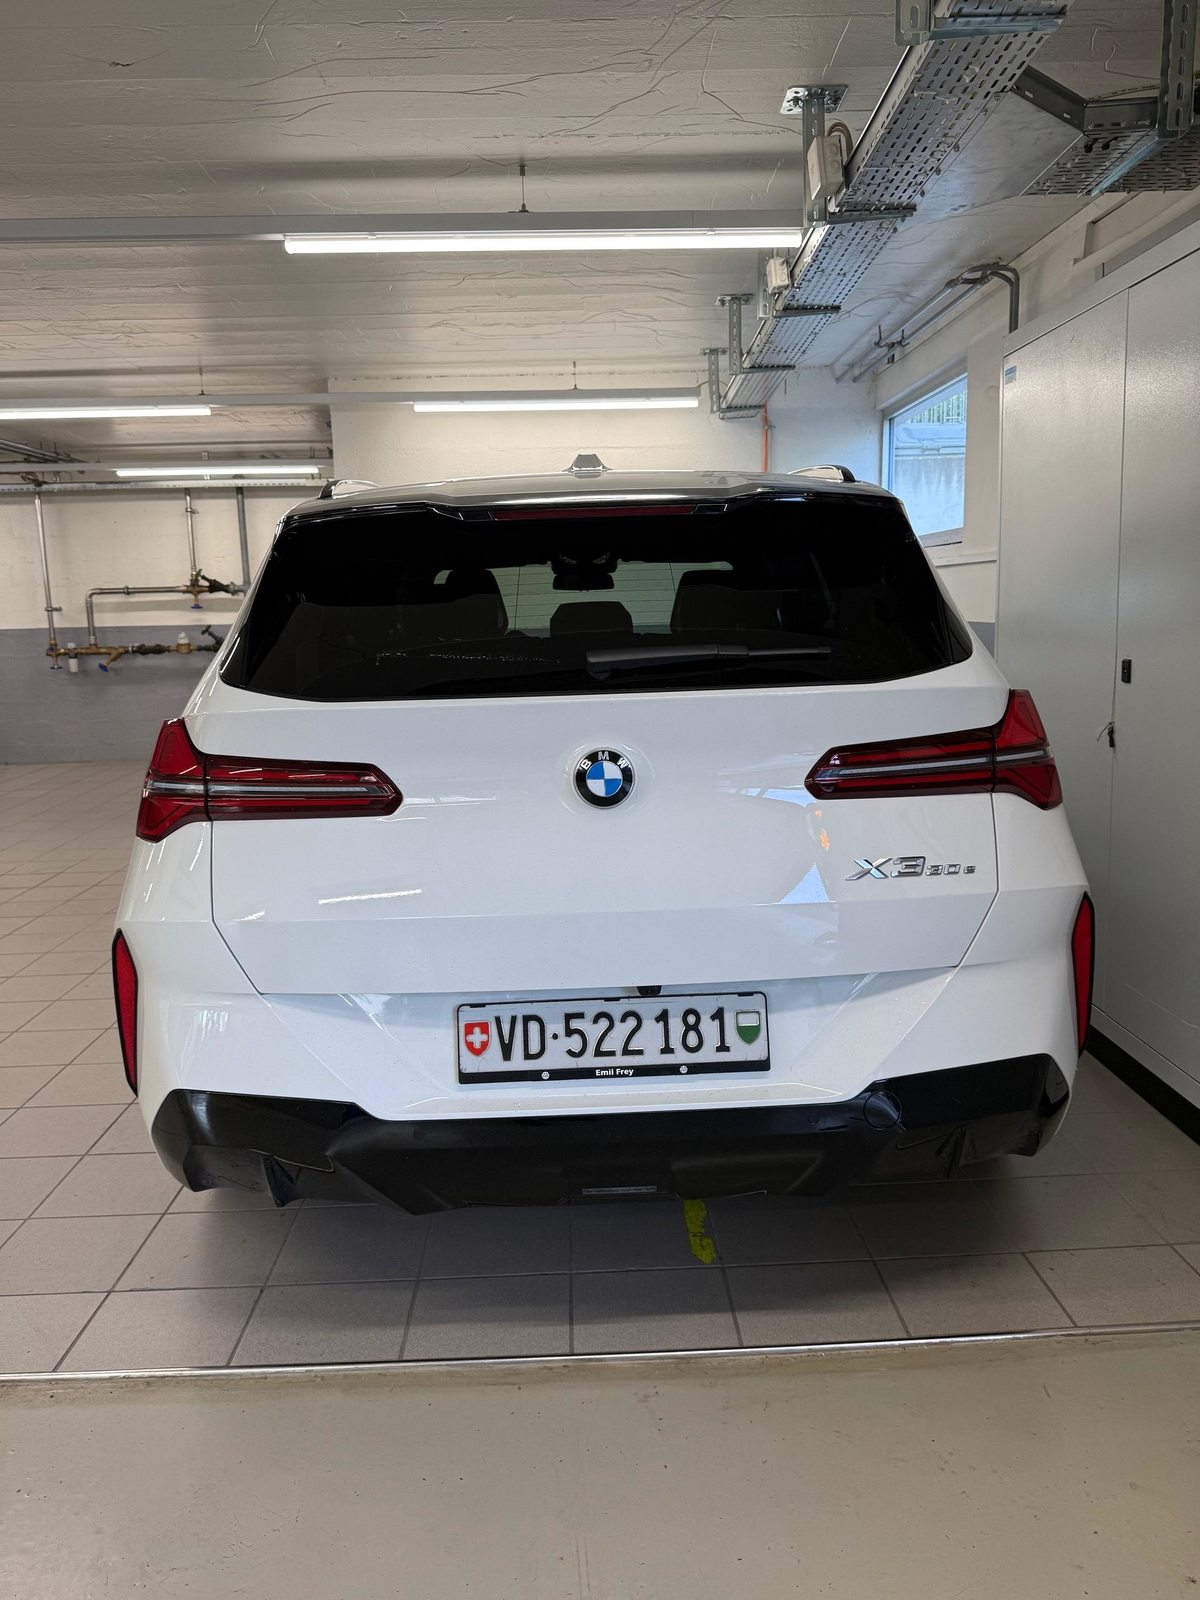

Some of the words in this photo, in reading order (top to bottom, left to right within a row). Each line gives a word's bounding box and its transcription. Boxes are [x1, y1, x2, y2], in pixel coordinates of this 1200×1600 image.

[580, 751, 630, 770] BMW
[845, 856, 926, 881] X3
[616, 1068, 634, 1076] Frey
